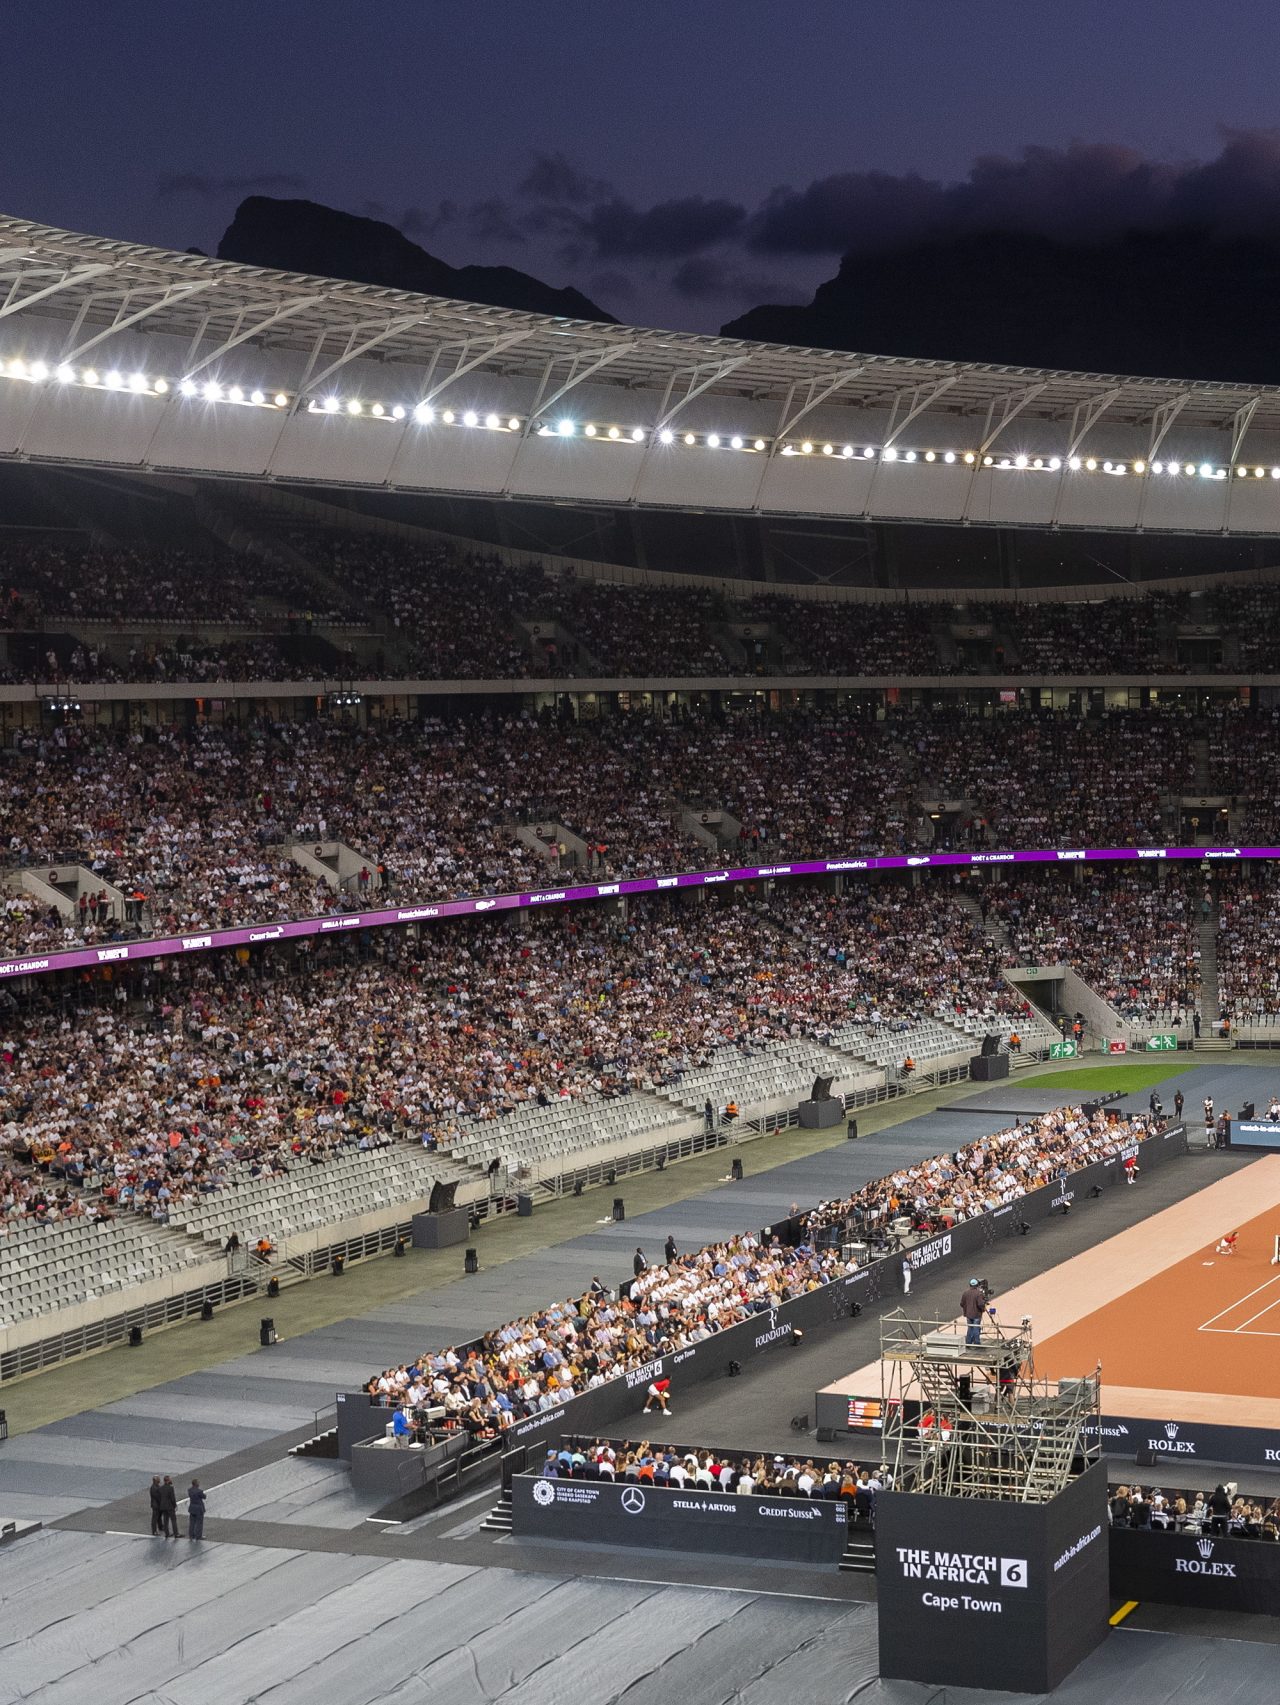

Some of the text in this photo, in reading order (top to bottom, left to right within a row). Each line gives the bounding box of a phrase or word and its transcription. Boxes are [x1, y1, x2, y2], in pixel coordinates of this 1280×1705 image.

[923, 1239, 942, 1252] MATCH
[920, 1253, 940, 1268] AFRICA
[755, 1322, 791, 1348] FOUNDATION
[517, 1410, 564, 1436] match-in-africa.com
[1148, 1439, 1196, 1453] ROLEX
[673, 1500, 736, 1513] STELLA ARTOIS
[758, 1505, 814, 1520] CREDIT SUISSE
[1054, 1525, 1101, 1572] match-in-africa.com
[896, 1548, 997, 1571] THE MATCH
[1176, 1558, 1236, 1577] ROLEX
[904, 1562, 989, 1584] IN AFRICA
[1006, 1564, 1022, 1582] 6
[922, 1592, 1002, 1613] Cape Town
